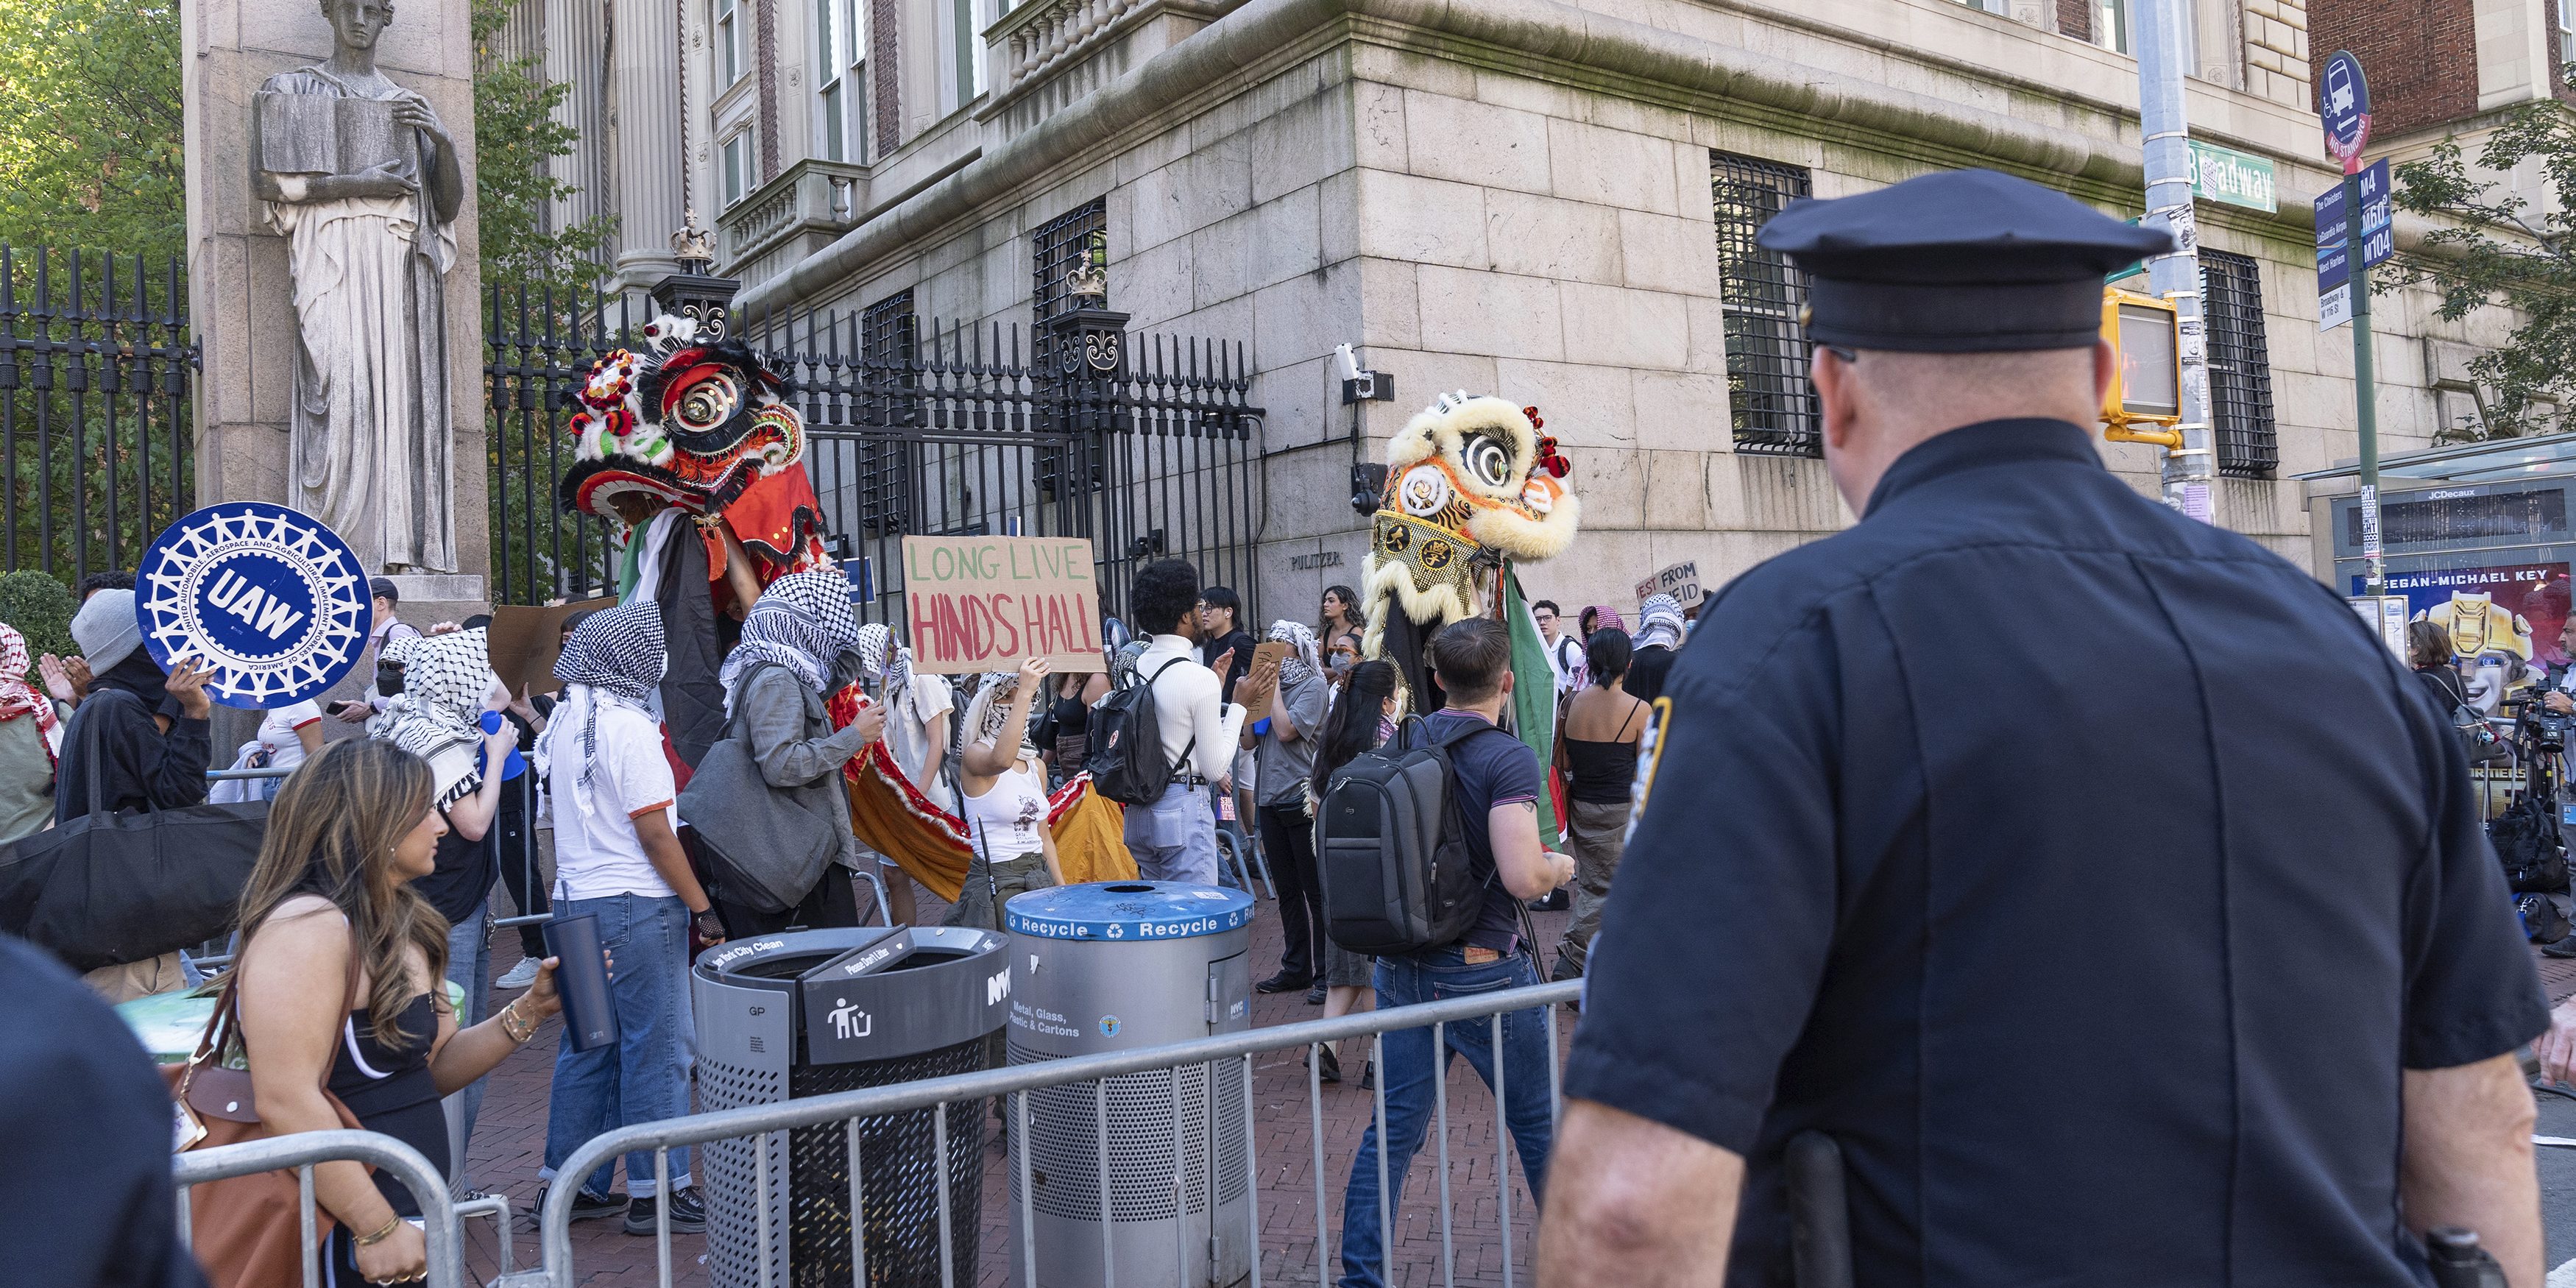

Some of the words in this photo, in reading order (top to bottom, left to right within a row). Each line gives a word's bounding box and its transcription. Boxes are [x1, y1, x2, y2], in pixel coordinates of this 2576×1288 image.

[2329, 136, 2339, 154] NO
[2340, 118, 2366, 158] STANDING
[2189, 148, 2271, 210] Bradway
[2360, 169, 2376, 198] M4
[2316, 201, 2324, 212] The
[2324, 191, 2342, 208] Cloisters
[2362, 202, 2385, 233] M60
[2317, 226, 2336, 244] LaGuardia
[2363, 230, 2391, 263] M104
[2318, 262, 2329, 275] West
[2329, 255, 2345, 269] Harlem
[2321, 293, 2339, 308] Broadway
[2321, 309, 2326, 319] W
[2429, 489, 2474, 500] JCDecaux
[206, 540, 249, 559] AEROSPACE
[275, 545, 322, 584] AGRICULTURAL
[909, 542, 1000, 581] LONG
[1010, 542, 1089, 580] LIVE
[1289, 551, 1344, 571] PULITZER
[181, 559, 206, 604] AUTOMOBILE,
[1661, 562, 1696, 588] FROM
[2516, 570, 2547, 581] KEY
[1669, 584, 1698, 602] EID
[208, 568, 304, 640] UAW
[319, 585, 330, 627] IMPLEMENT
[182, 606, 194, 633] UNITED
[911, 592, 1019, 662] HIND'S
[1022, 593, 1103, 657] HALL
[299, 629, 325, 657] WORKERS
[248, 662, 283, 670] AMERICA
[288, 656, 297, 665] OF
[1022, 916, 1089, 937] Recycle
[1139, 918, 1218, 937] Recycle
[735, 946, 754, 956] City
[753, 941, 785, 952] Clean
[749, 1006, 765, 1016] GP
[1013, 1000, 1034, 1019] Metal,
[1036, 1008, 1067, 1025] Glass,
[1230, 1001, 1243, 1014] NYC
[1030, 1020, 1036, 1030] &
[1038, 1022, 1080, 1037] Cartons
